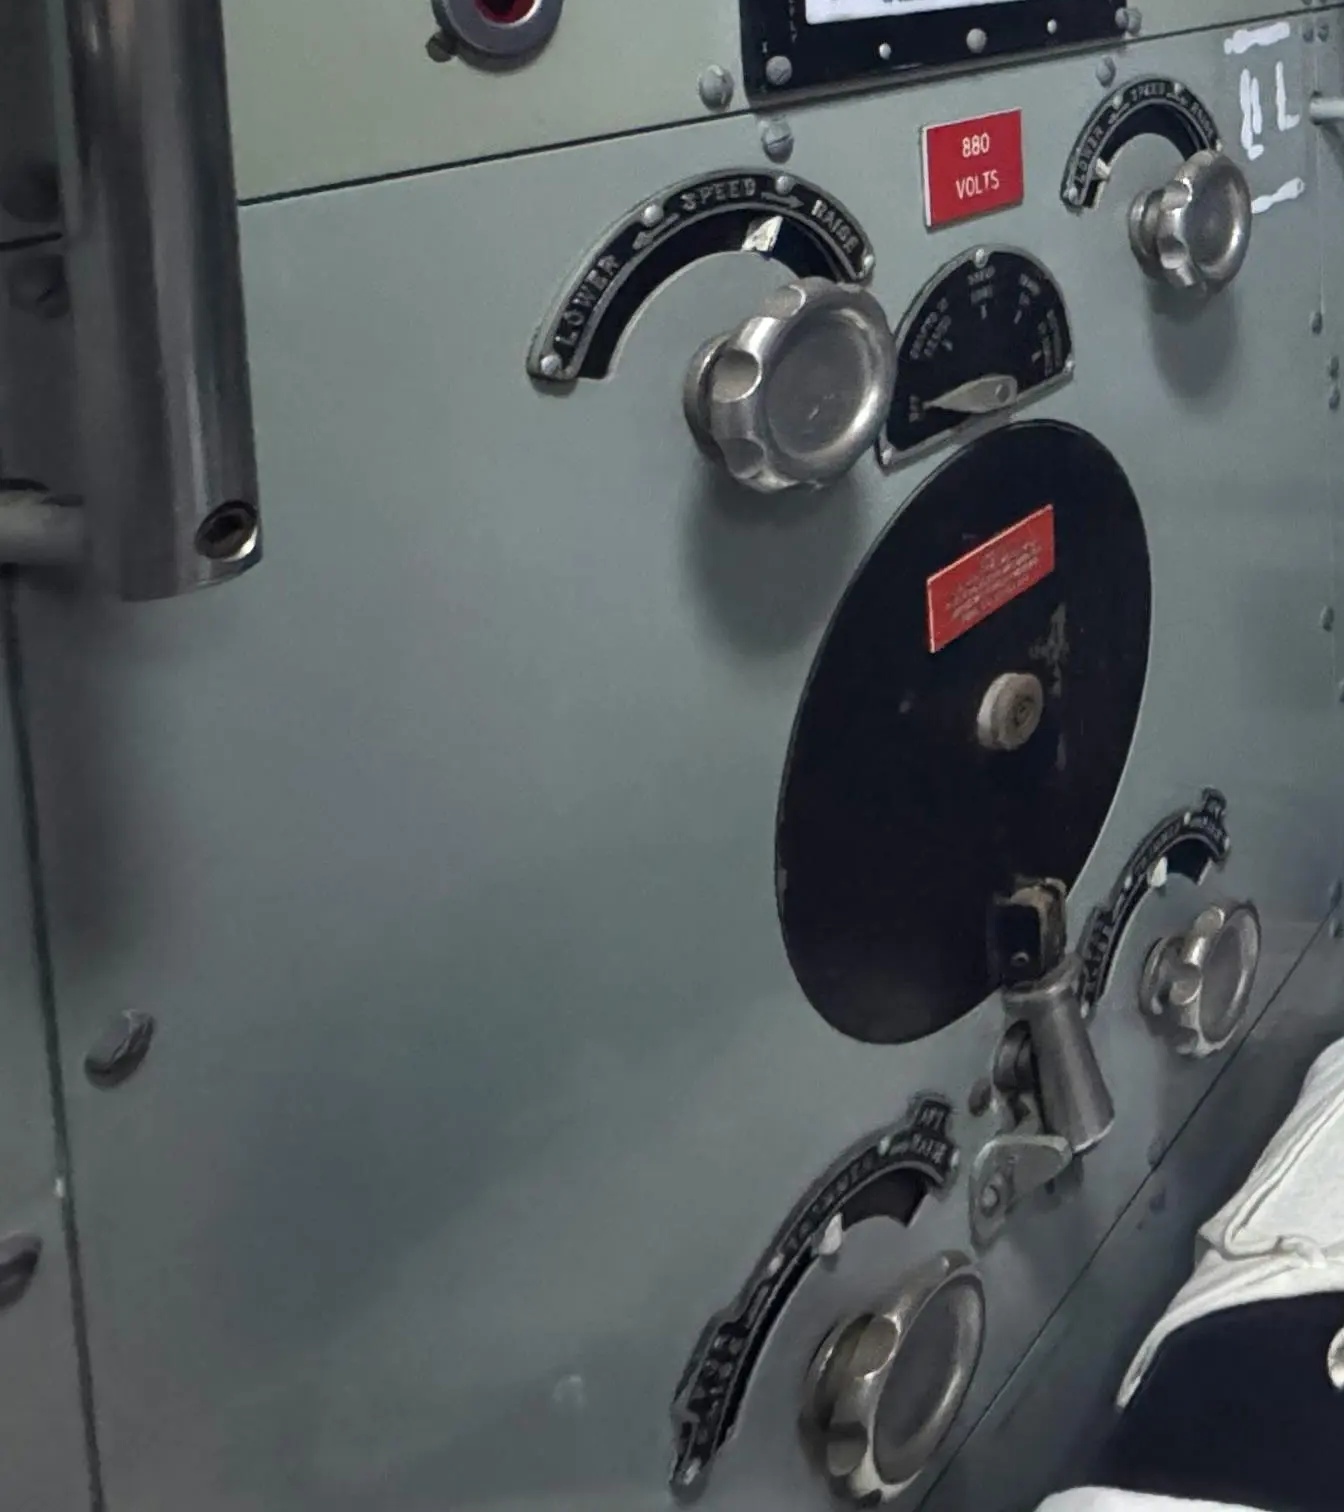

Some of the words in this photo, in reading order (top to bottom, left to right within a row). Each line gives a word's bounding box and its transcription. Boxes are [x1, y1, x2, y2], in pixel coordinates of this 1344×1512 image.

[962, 132, 989, 158] 880
[681, 177, 757, 211] SPEED
[955, 169, 1000, 200] VOLTS
[811, 199, 859, 254] RAISE
[555, 254, 621, 346] LOWER
